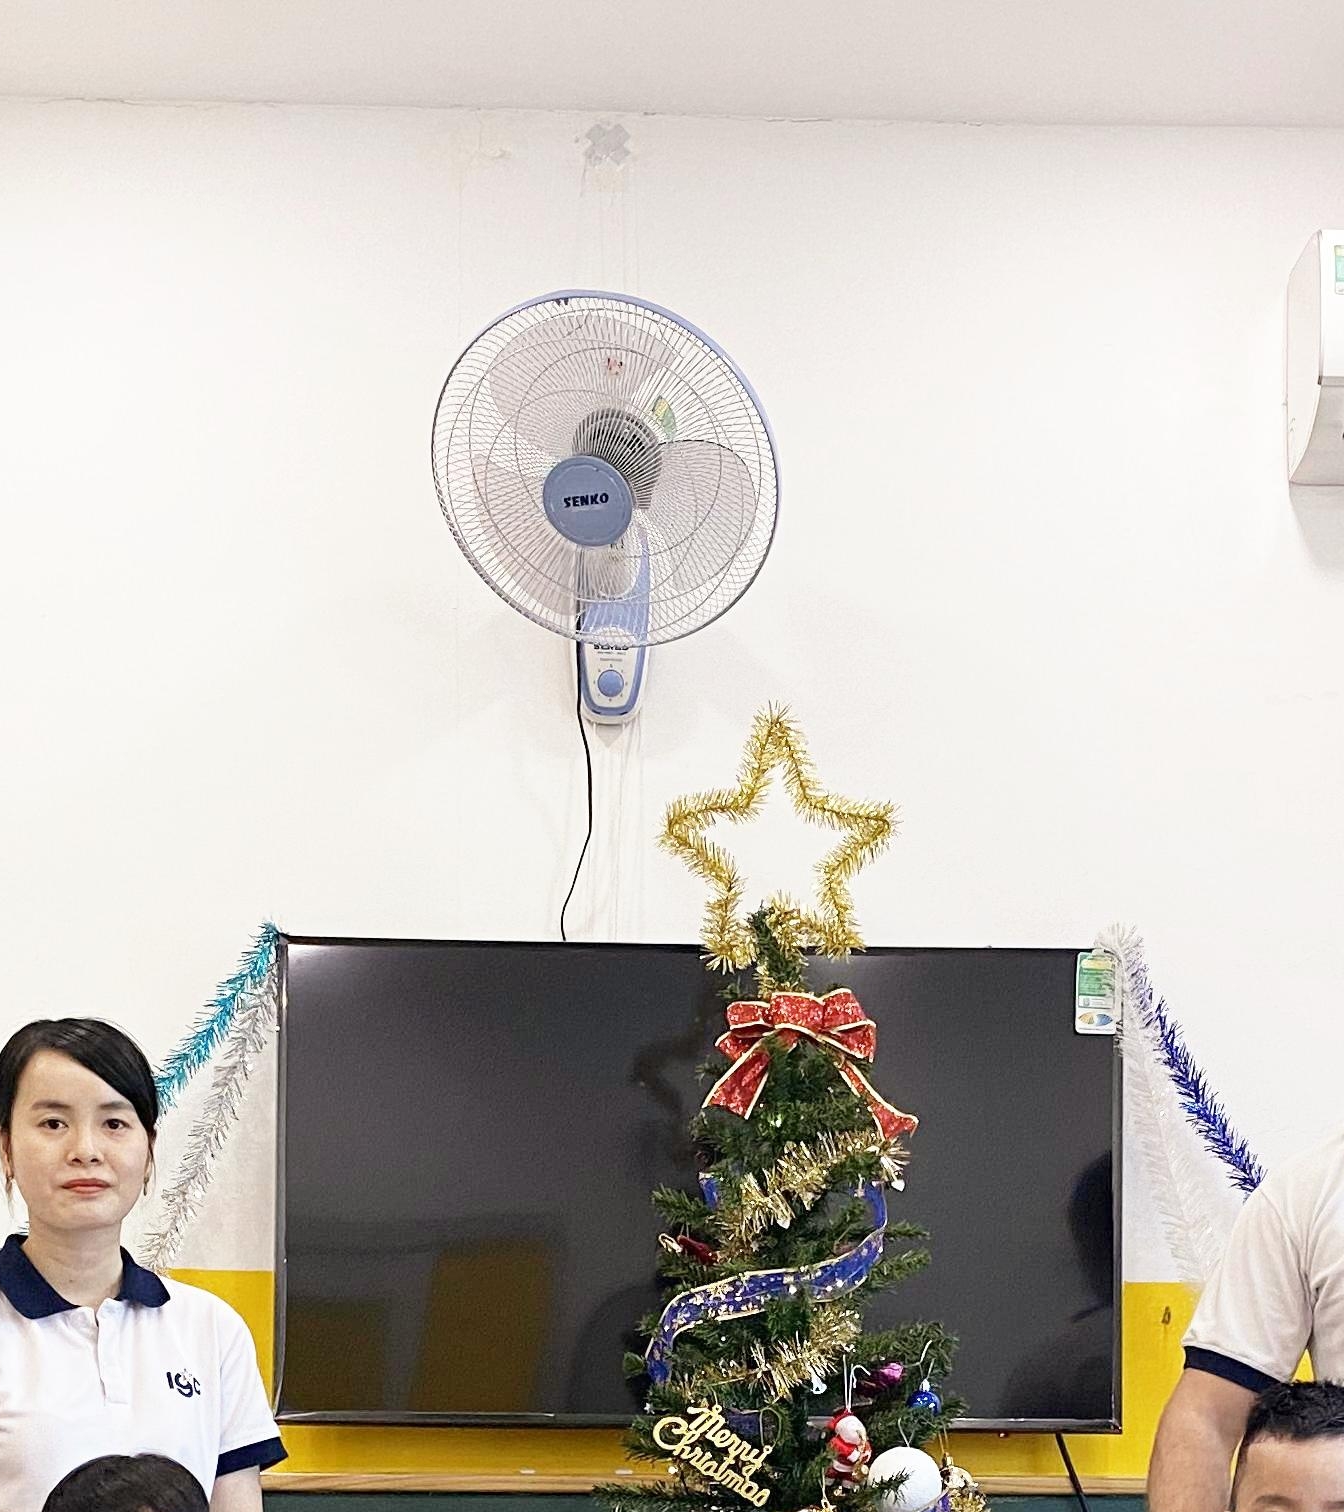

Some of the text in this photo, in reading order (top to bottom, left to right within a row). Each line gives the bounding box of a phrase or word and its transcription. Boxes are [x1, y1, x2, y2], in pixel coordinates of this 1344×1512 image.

[563, 492, 609, 509] SENKO
[653, 1416, 771, 1508] Christmas
[687, 1406, 770, 1480] Merry
